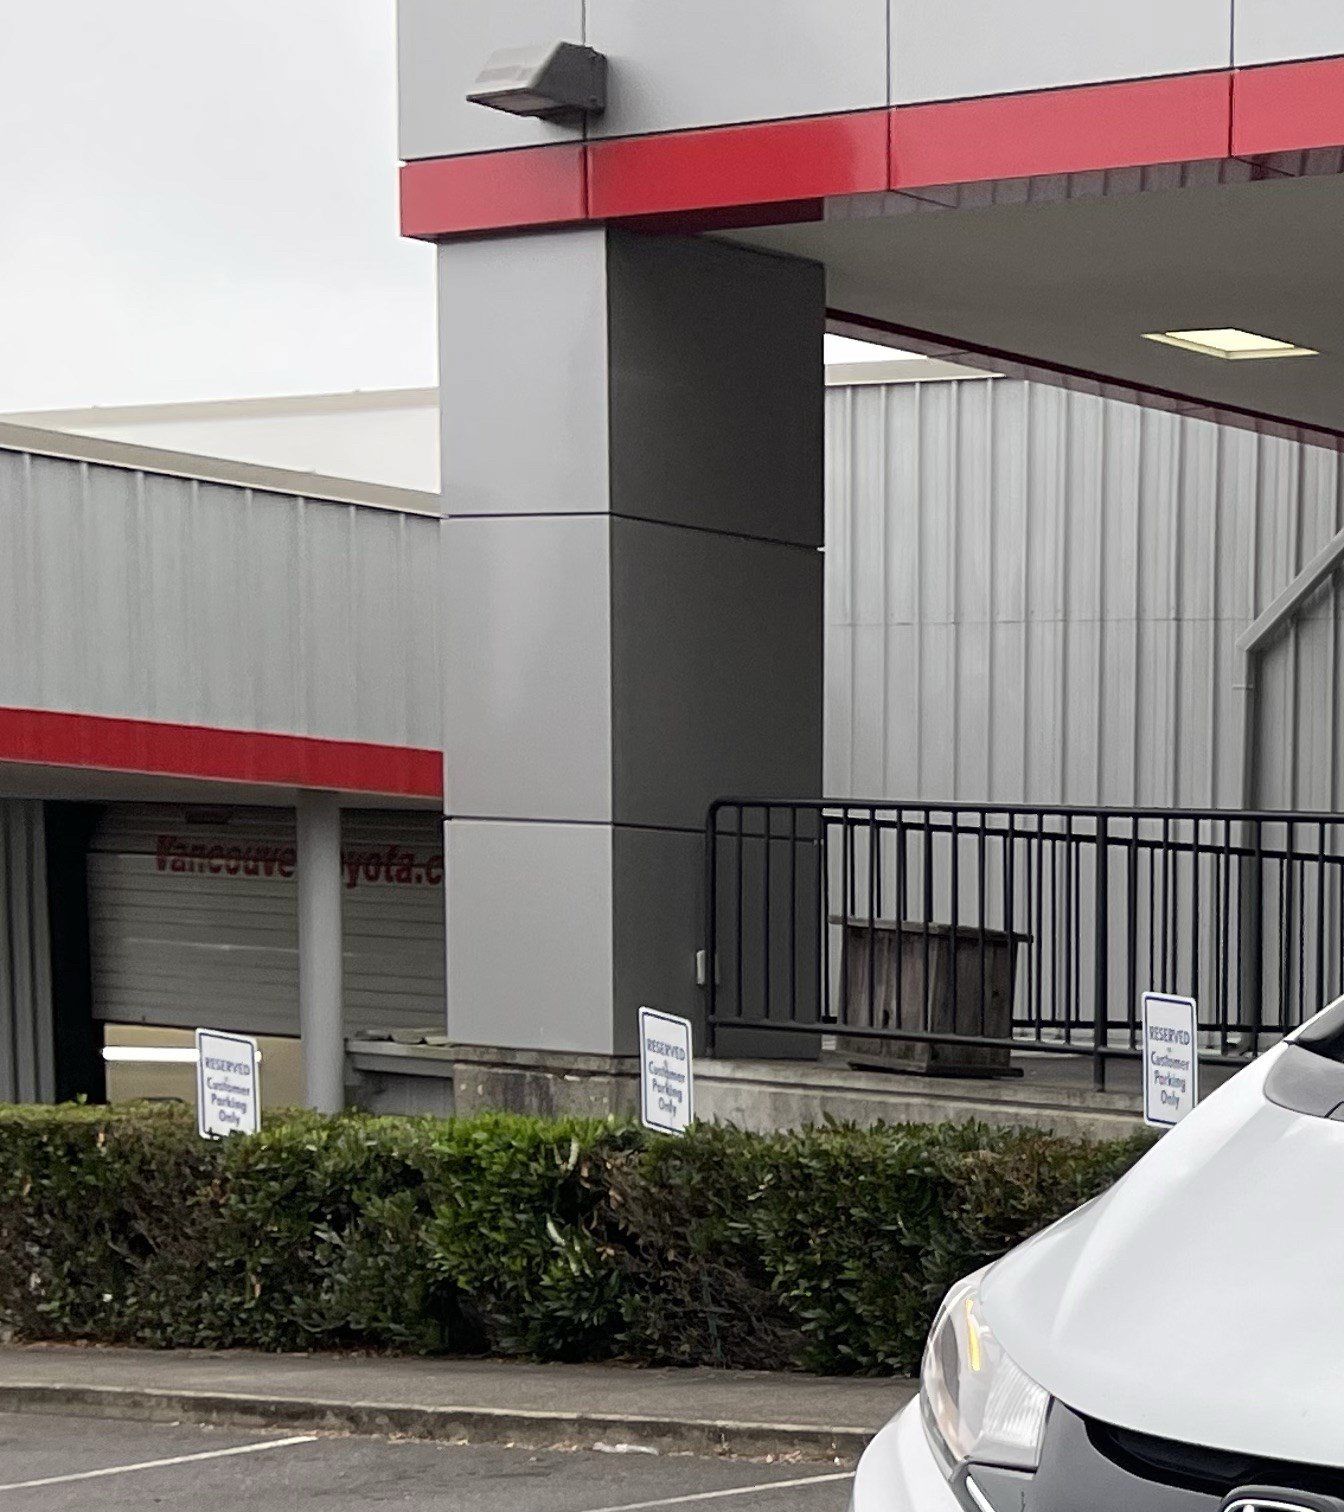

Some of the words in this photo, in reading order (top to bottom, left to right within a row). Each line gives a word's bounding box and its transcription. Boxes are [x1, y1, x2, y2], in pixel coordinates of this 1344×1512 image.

[1149, 1026, 1189, 1045] RESERVED
[1150, 1051, 1190, 1071] Customer
[1154, 1070, 1185, 1092] Parking
[211, 1093, 247, 1114] Parking
[1161, 1090, 1179, 1109] Only
